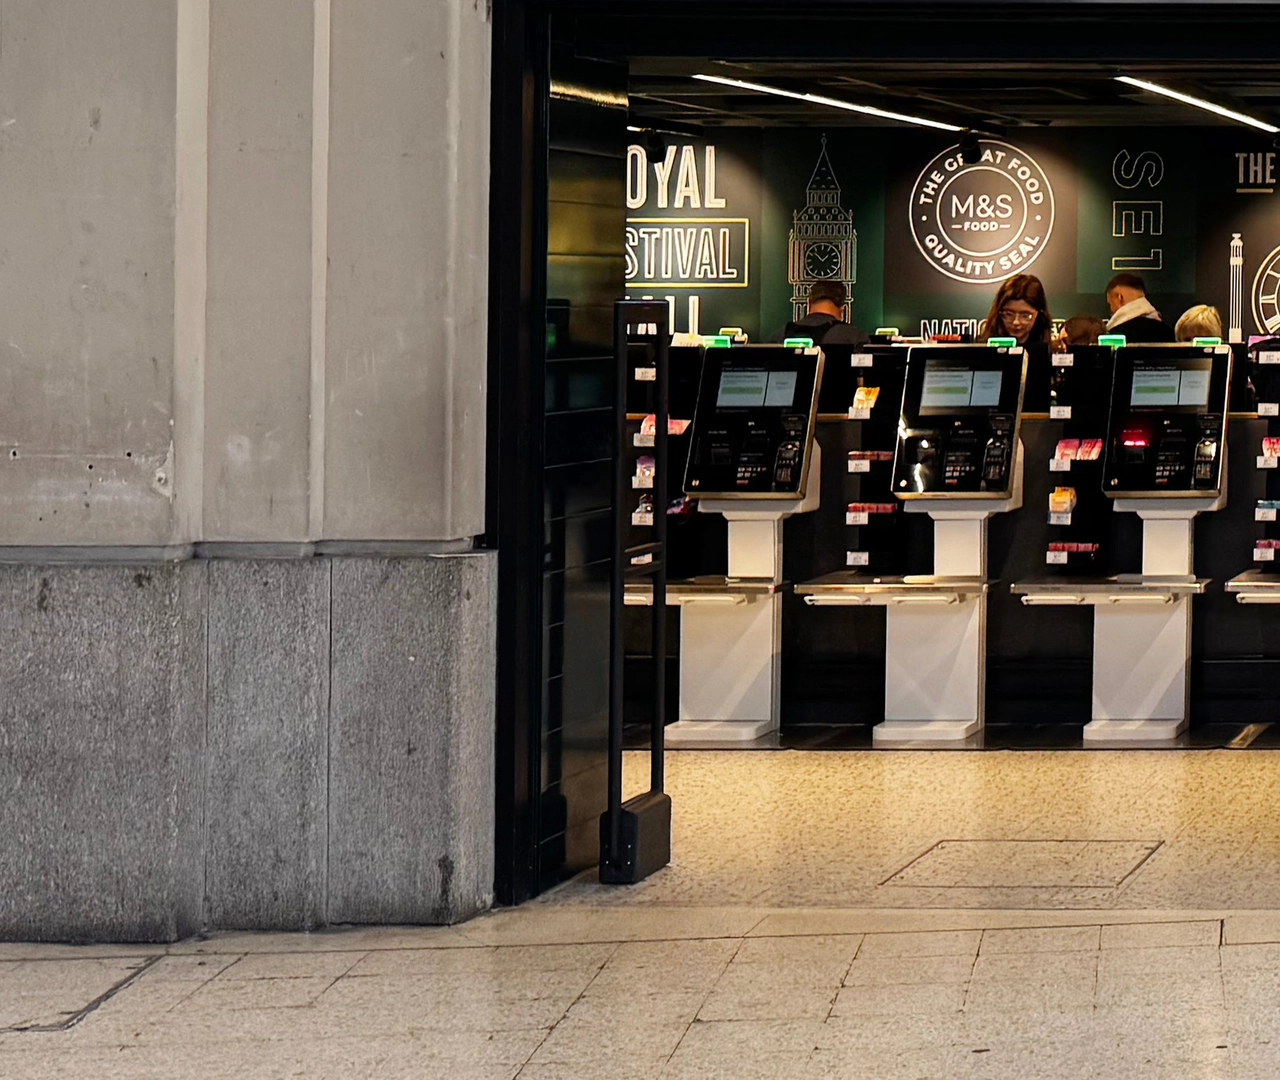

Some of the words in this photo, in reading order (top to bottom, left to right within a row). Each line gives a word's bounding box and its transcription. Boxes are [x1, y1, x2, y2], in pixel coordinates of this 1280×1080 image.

[919, 170, 945, 205] THE
[1007, 157, 1044, 205] FOOD
[1235, 152, 1276, 184] THE
[951, 194, 1013, 219] M&S
[963, 221, 999, 232] FOOD
[924, 234, 996, 275] QUALITY
[999, 235, 1040, 271] SEAL
